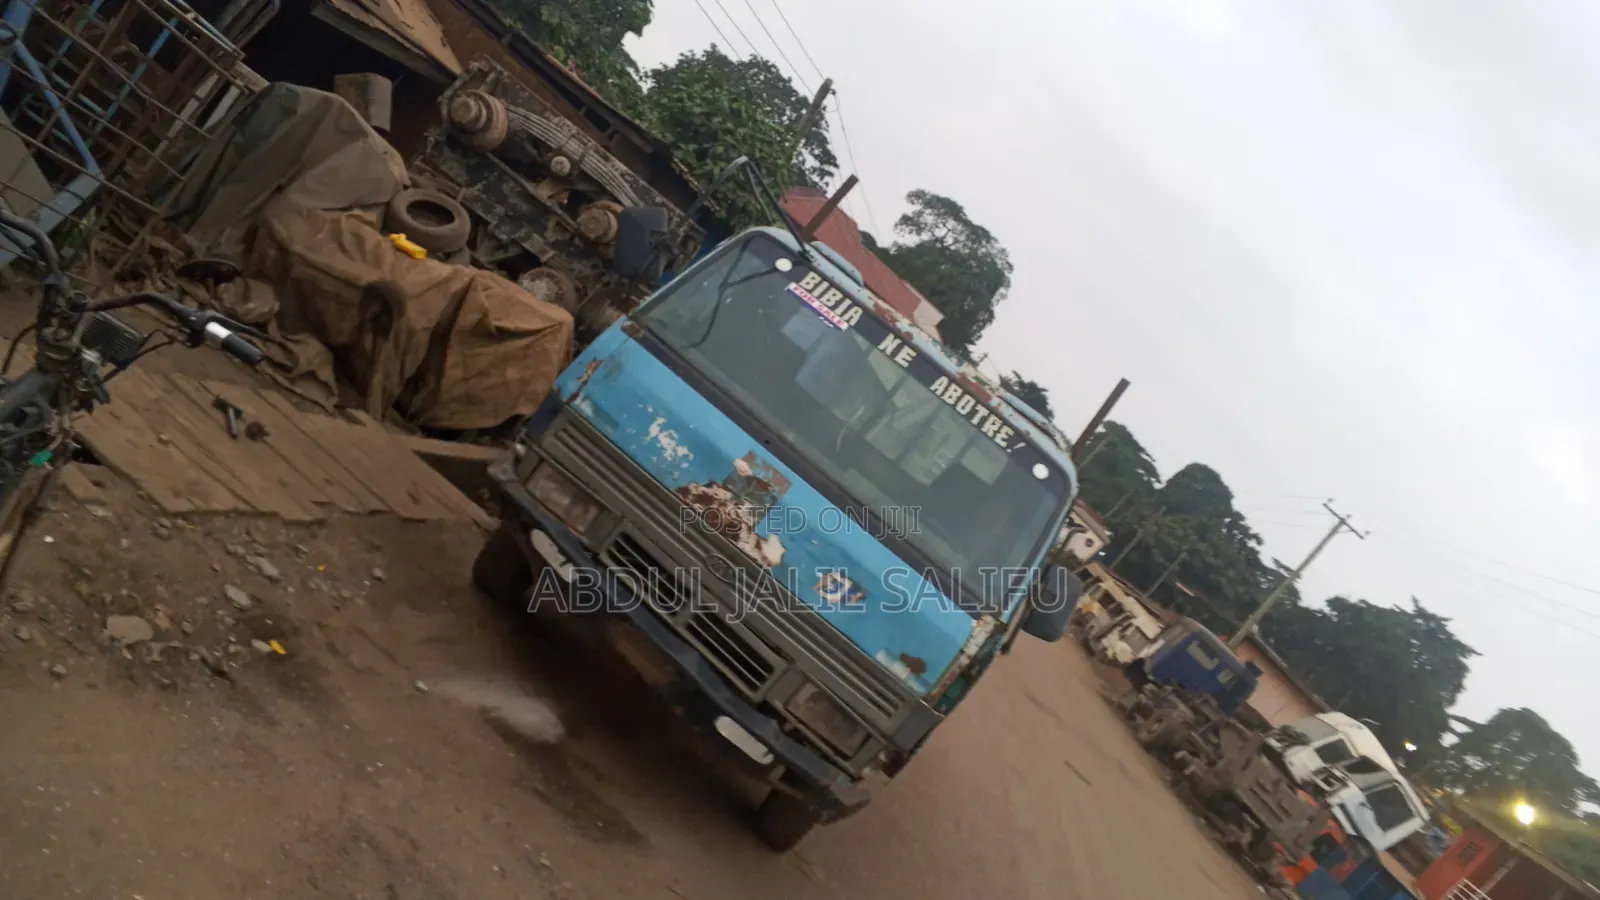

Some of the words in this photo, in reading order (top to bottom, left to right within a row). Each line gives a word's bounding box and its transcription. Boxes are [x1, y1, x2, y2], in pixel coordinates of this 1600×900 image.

[793, 285, 815, 304] FOR
[816, 303, 846, 327] SALE
[799, 270, 863, 326] BIBIA
[877, 332, 917, 368] NE
[929, 375, 1026, 453] ABOTRE!
